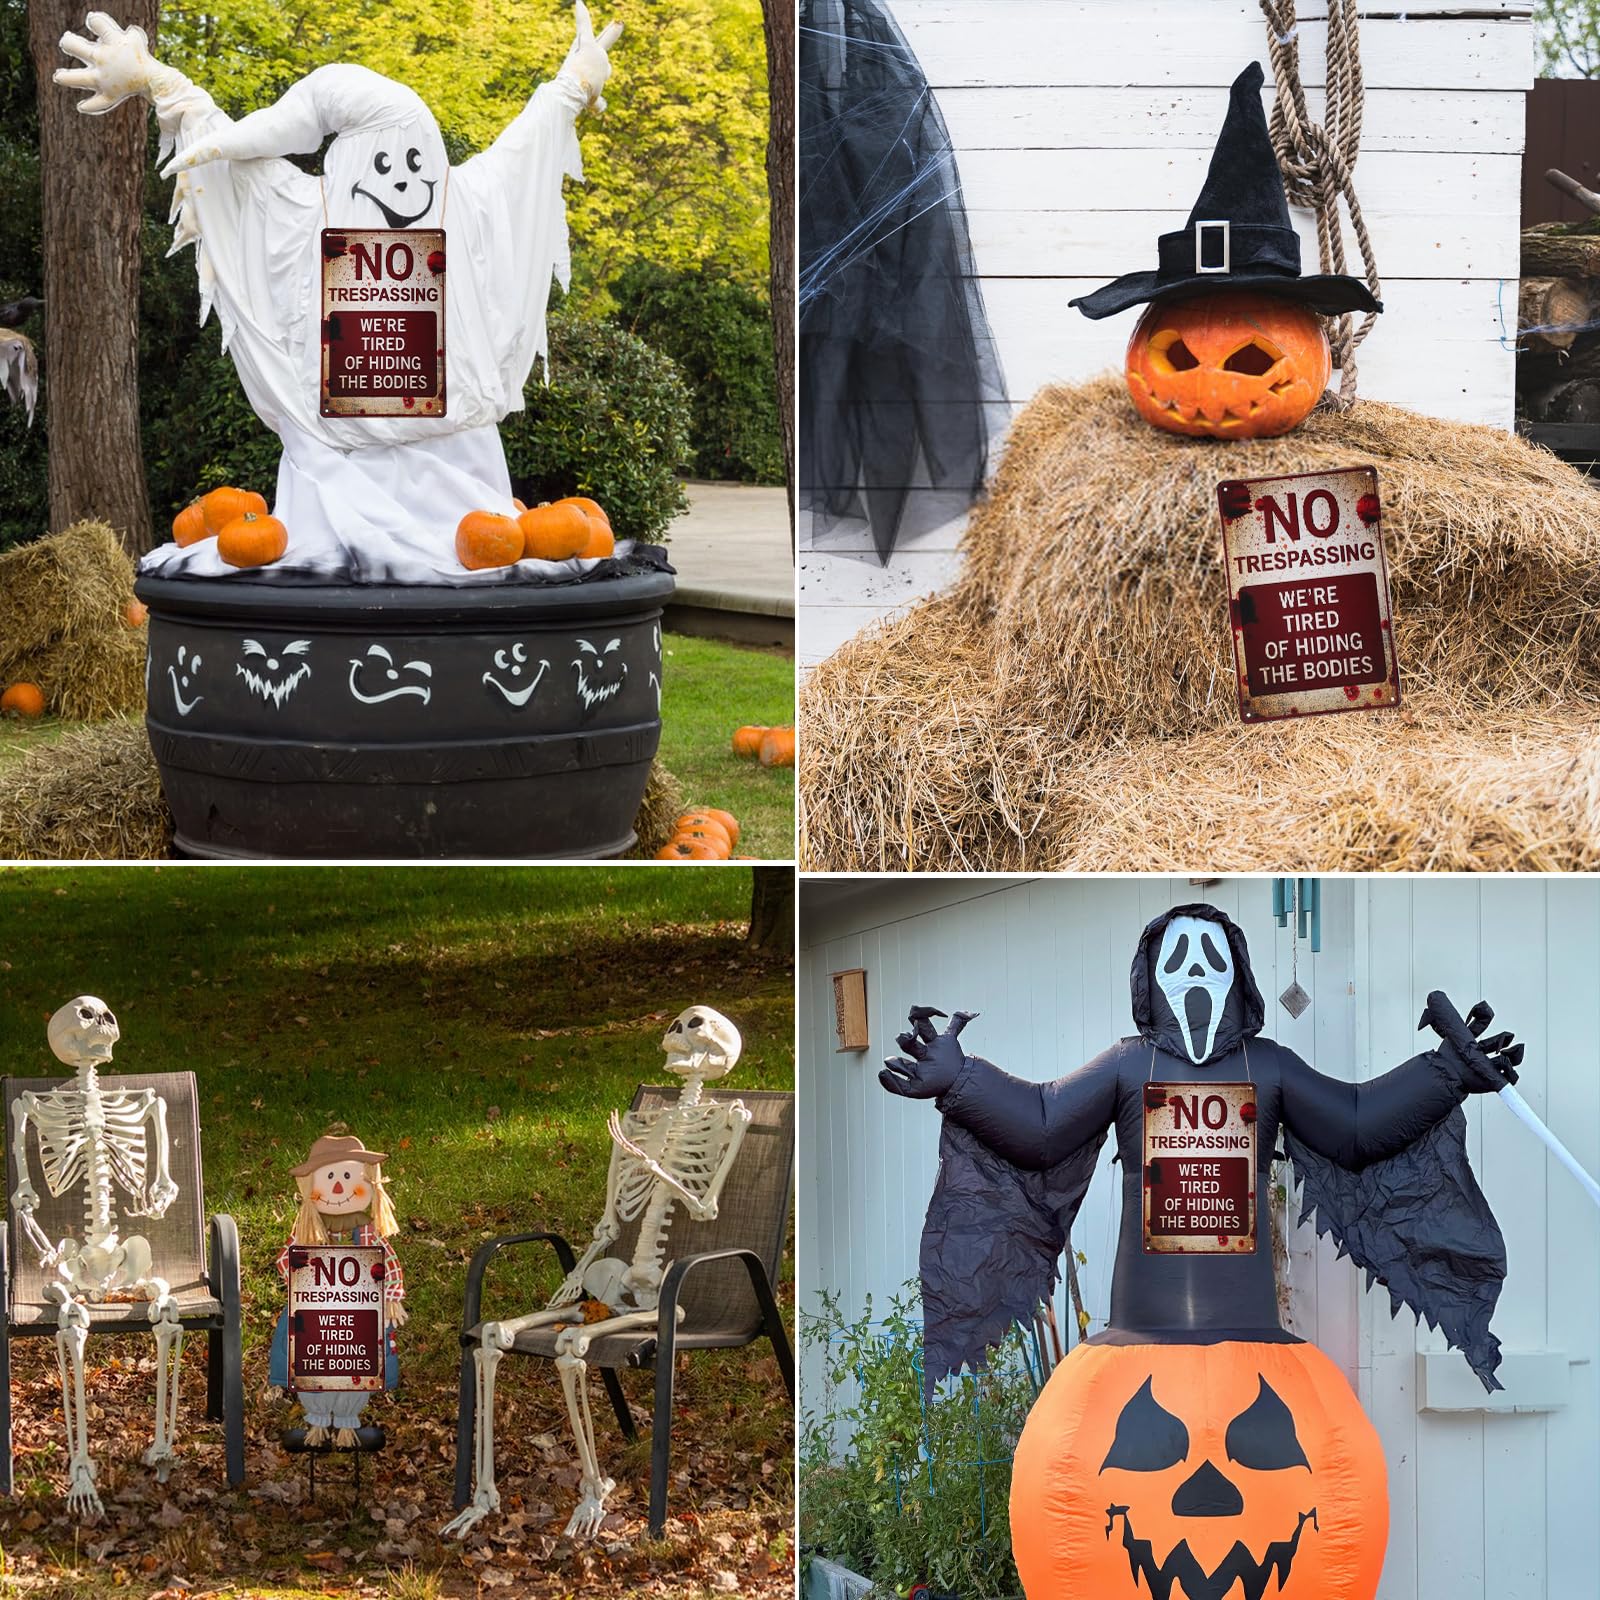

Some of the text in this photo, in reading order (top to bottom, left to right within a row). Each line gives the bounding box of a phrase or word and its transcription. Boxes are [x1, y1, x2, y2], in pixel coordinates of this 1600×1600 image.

[355, 243, 414, 281] NO
[328, 288, 438, 301] TRESPASSING
[361, 318, 406, 332] WE'RE
[361, 337, 405, 351] TIRED
[345, 356, 421, 370] OF HIDING
[339, 375, 427, 389] THE BODIES
[1262, 489, 1340, 544] NO
[1234, 542, 1375, 574] TRESPASSING
[1279, 586, 1339, 608] WE'RE
[1283, 611, 1339, 632] TIRED
[1265, 632, 1363, 659] OF HIDING
[1259, 656, 1373, 684] THE BODIES
[1174, 1095, 1227, 1130] NO
[1150, 1136, 1249, 1149] TRESPASSING
[1179, 1164, 1220, 1176] WE'RE
[1180, 1181, 1219, 1194] TIRED
[1165, 1198, 1234, 1211] OF HIDING
[1160, 1216, 1240, 1228] THE BODIES
[315, 1257, 360, 1286] NO
[294, 1292, 379, 1302] TRESPASSING
[319, 1315, 354, 1326] WE'RE
[320, 1330, 353, 1340] TIRED
[307, 1345, 366, 1355] OF HIDING
[302, 1359, 370, 1370] THE BODIES
